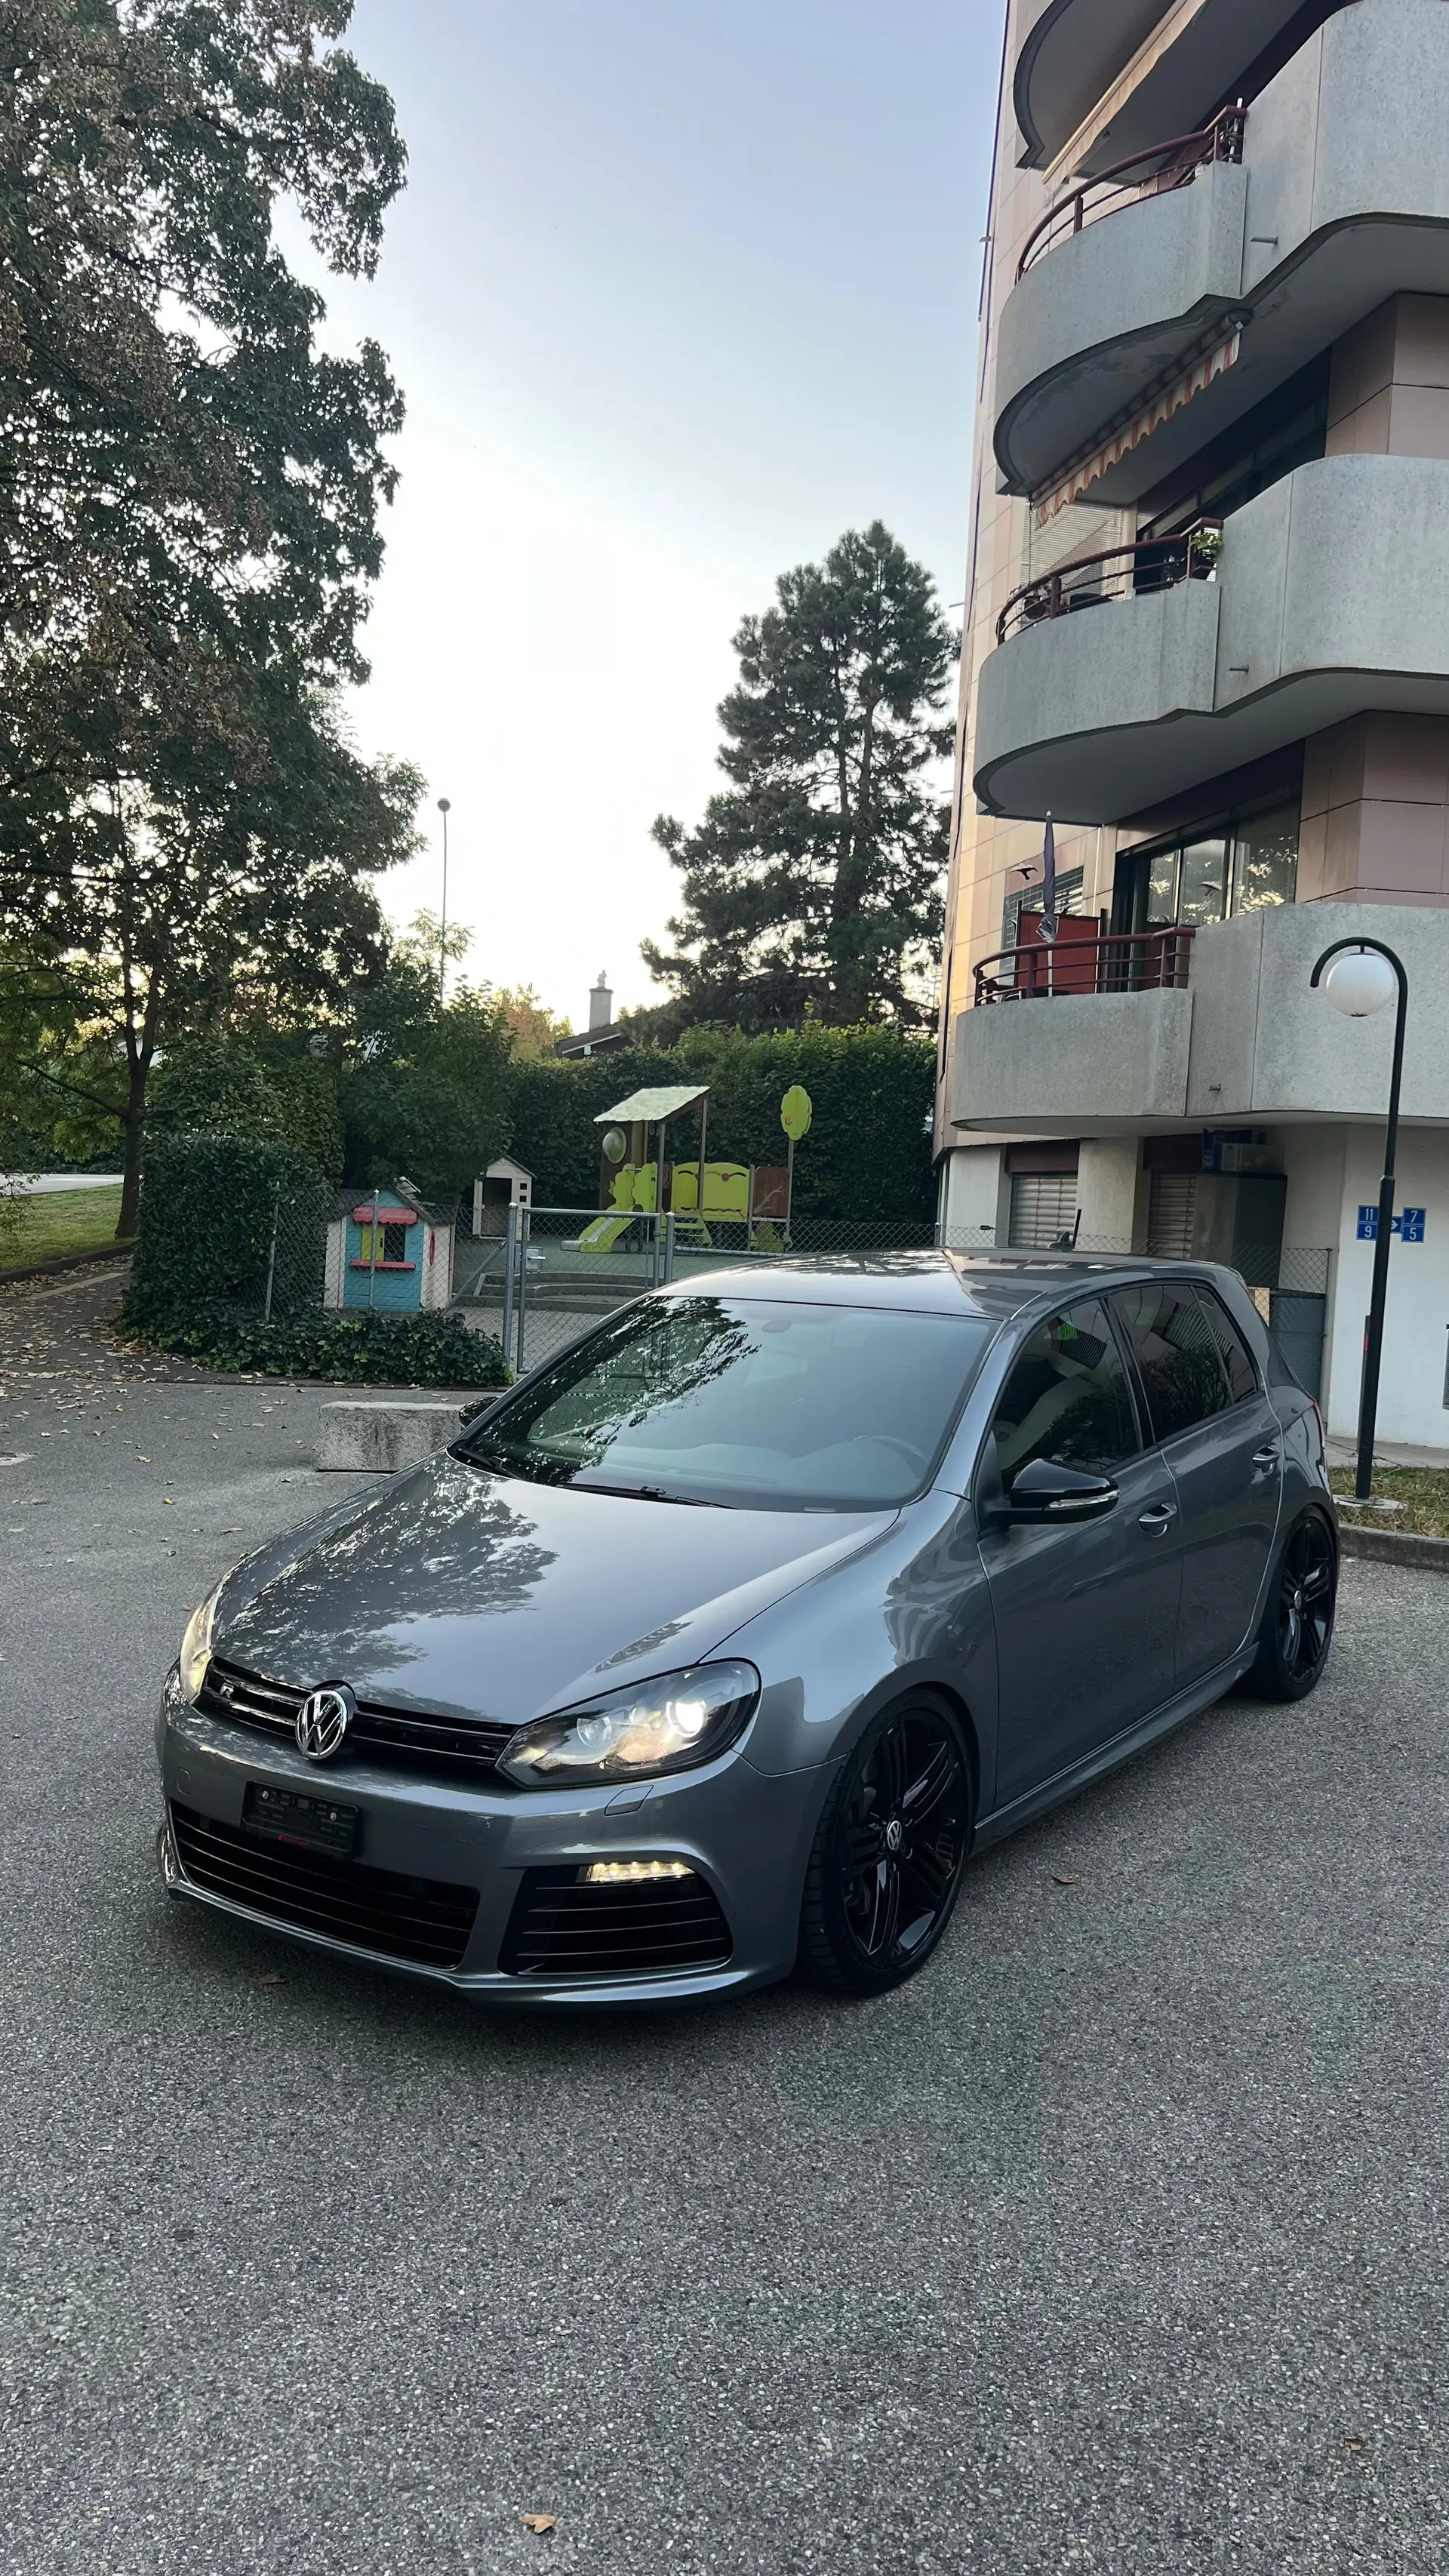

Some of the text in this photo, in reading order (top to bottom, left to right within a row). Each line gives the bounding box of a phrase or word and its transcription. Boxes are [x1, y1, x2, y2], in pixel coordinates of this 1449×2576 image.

[1365, 1208, 1373, 1220] 11
[1411, 1211, 1418, 1223] 7
[1364, 1226, 1372, 1238] 9
[1410, 1227, 1417, 1240] 5
[220, 1682, 234, 1698] R
[295, 1689, 348, 1759] VW
